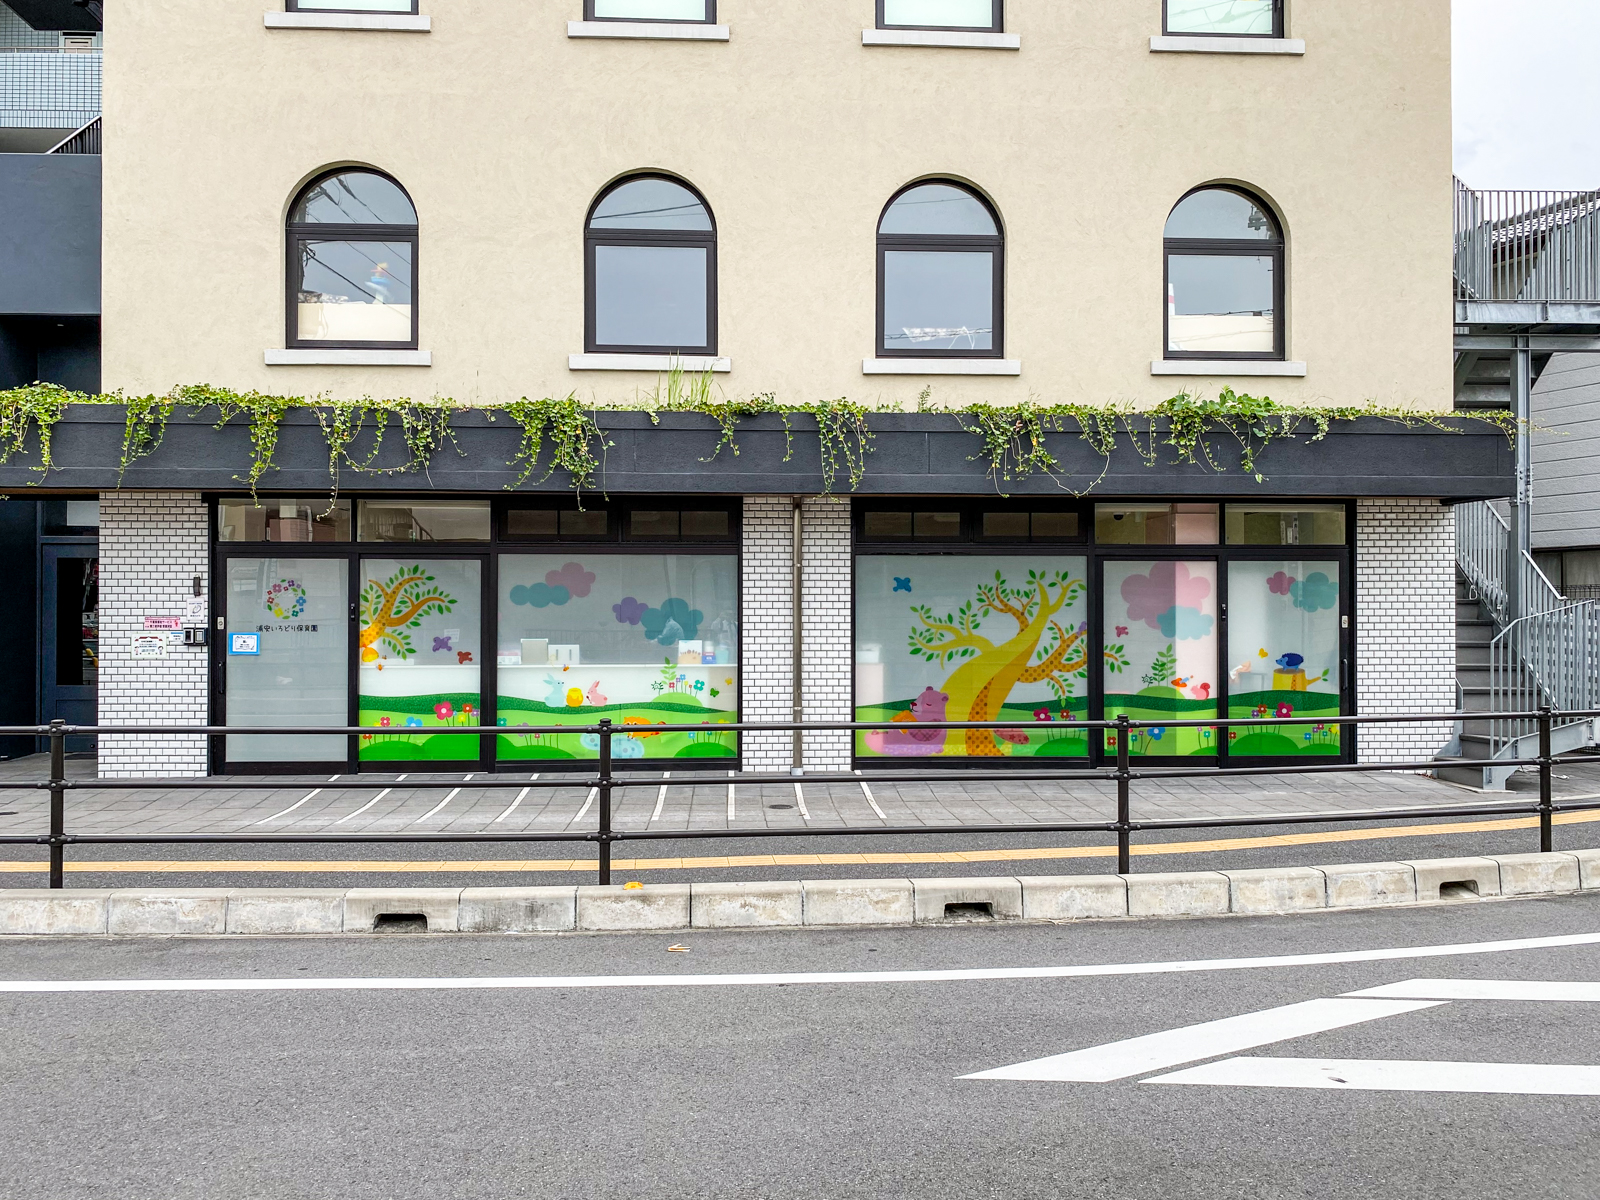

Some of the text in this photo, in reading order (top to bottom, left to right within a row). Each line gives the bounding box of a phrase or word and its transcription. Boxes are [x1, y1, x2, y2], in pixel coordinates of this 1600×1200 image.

[255, 624, 318, 632] 浦安いろどり保育園
